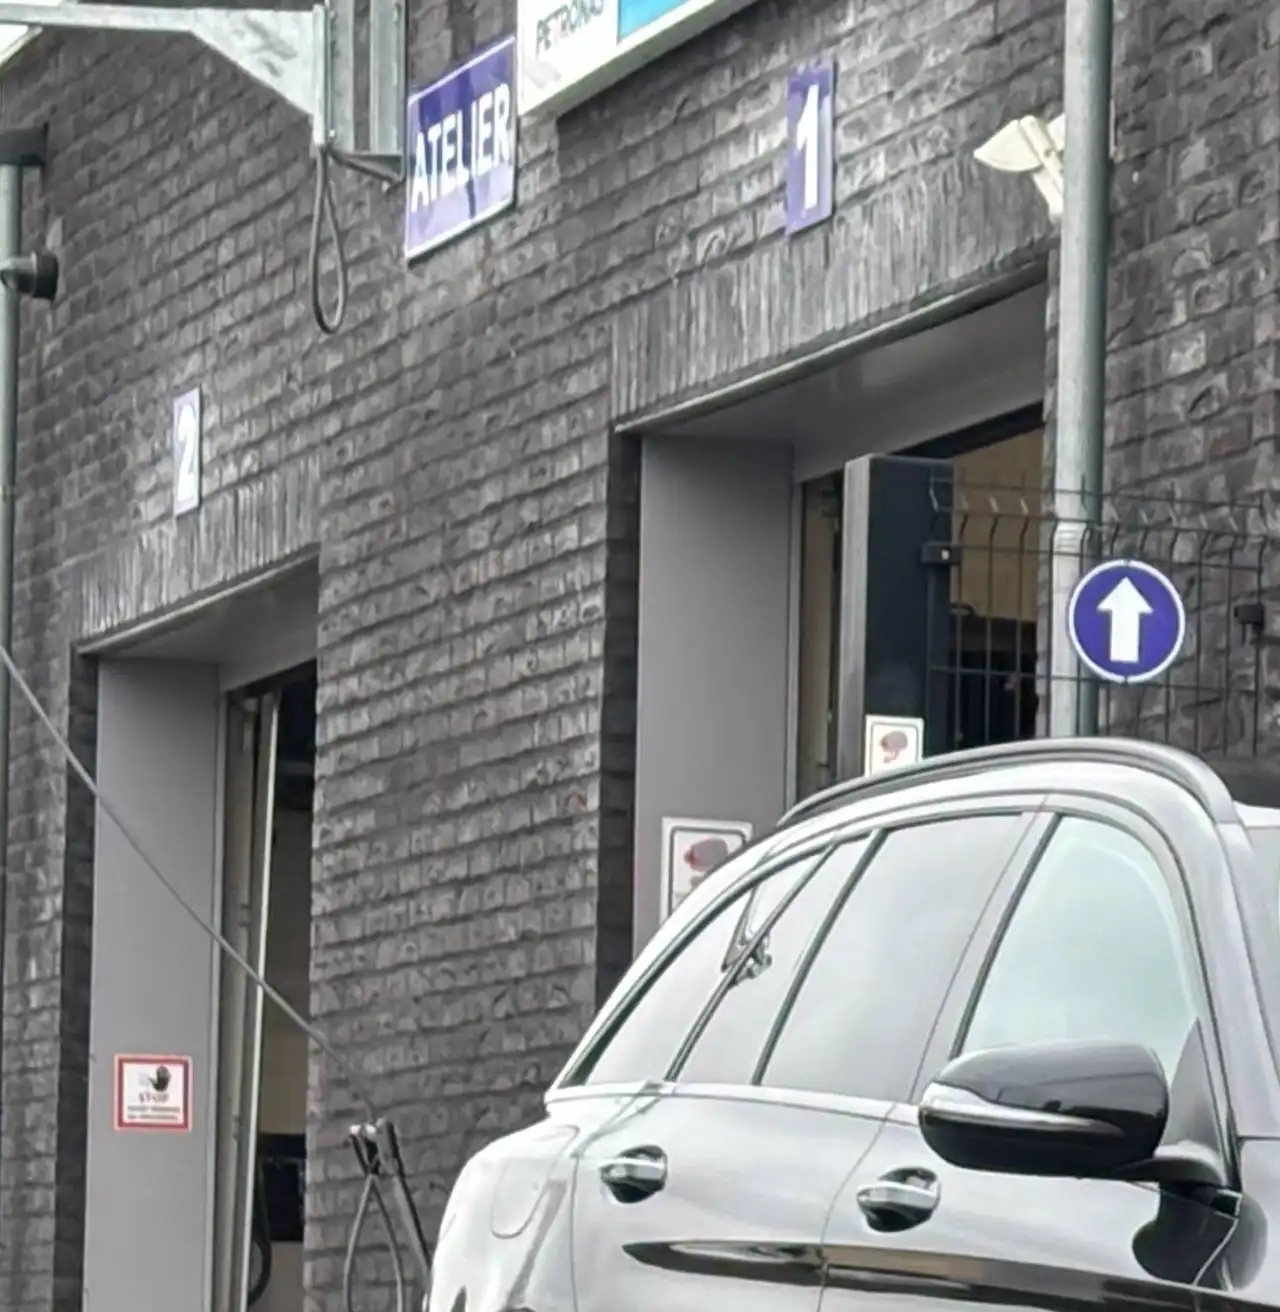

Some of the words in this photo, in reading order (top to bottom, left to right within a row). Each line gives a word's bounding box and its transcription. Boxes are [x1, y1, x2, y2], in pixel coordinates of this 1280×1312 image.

[411, 83, 511, 213] ATELIER
[796, 84, 819, 209] 1
[178, 404, 197, 502] 2
